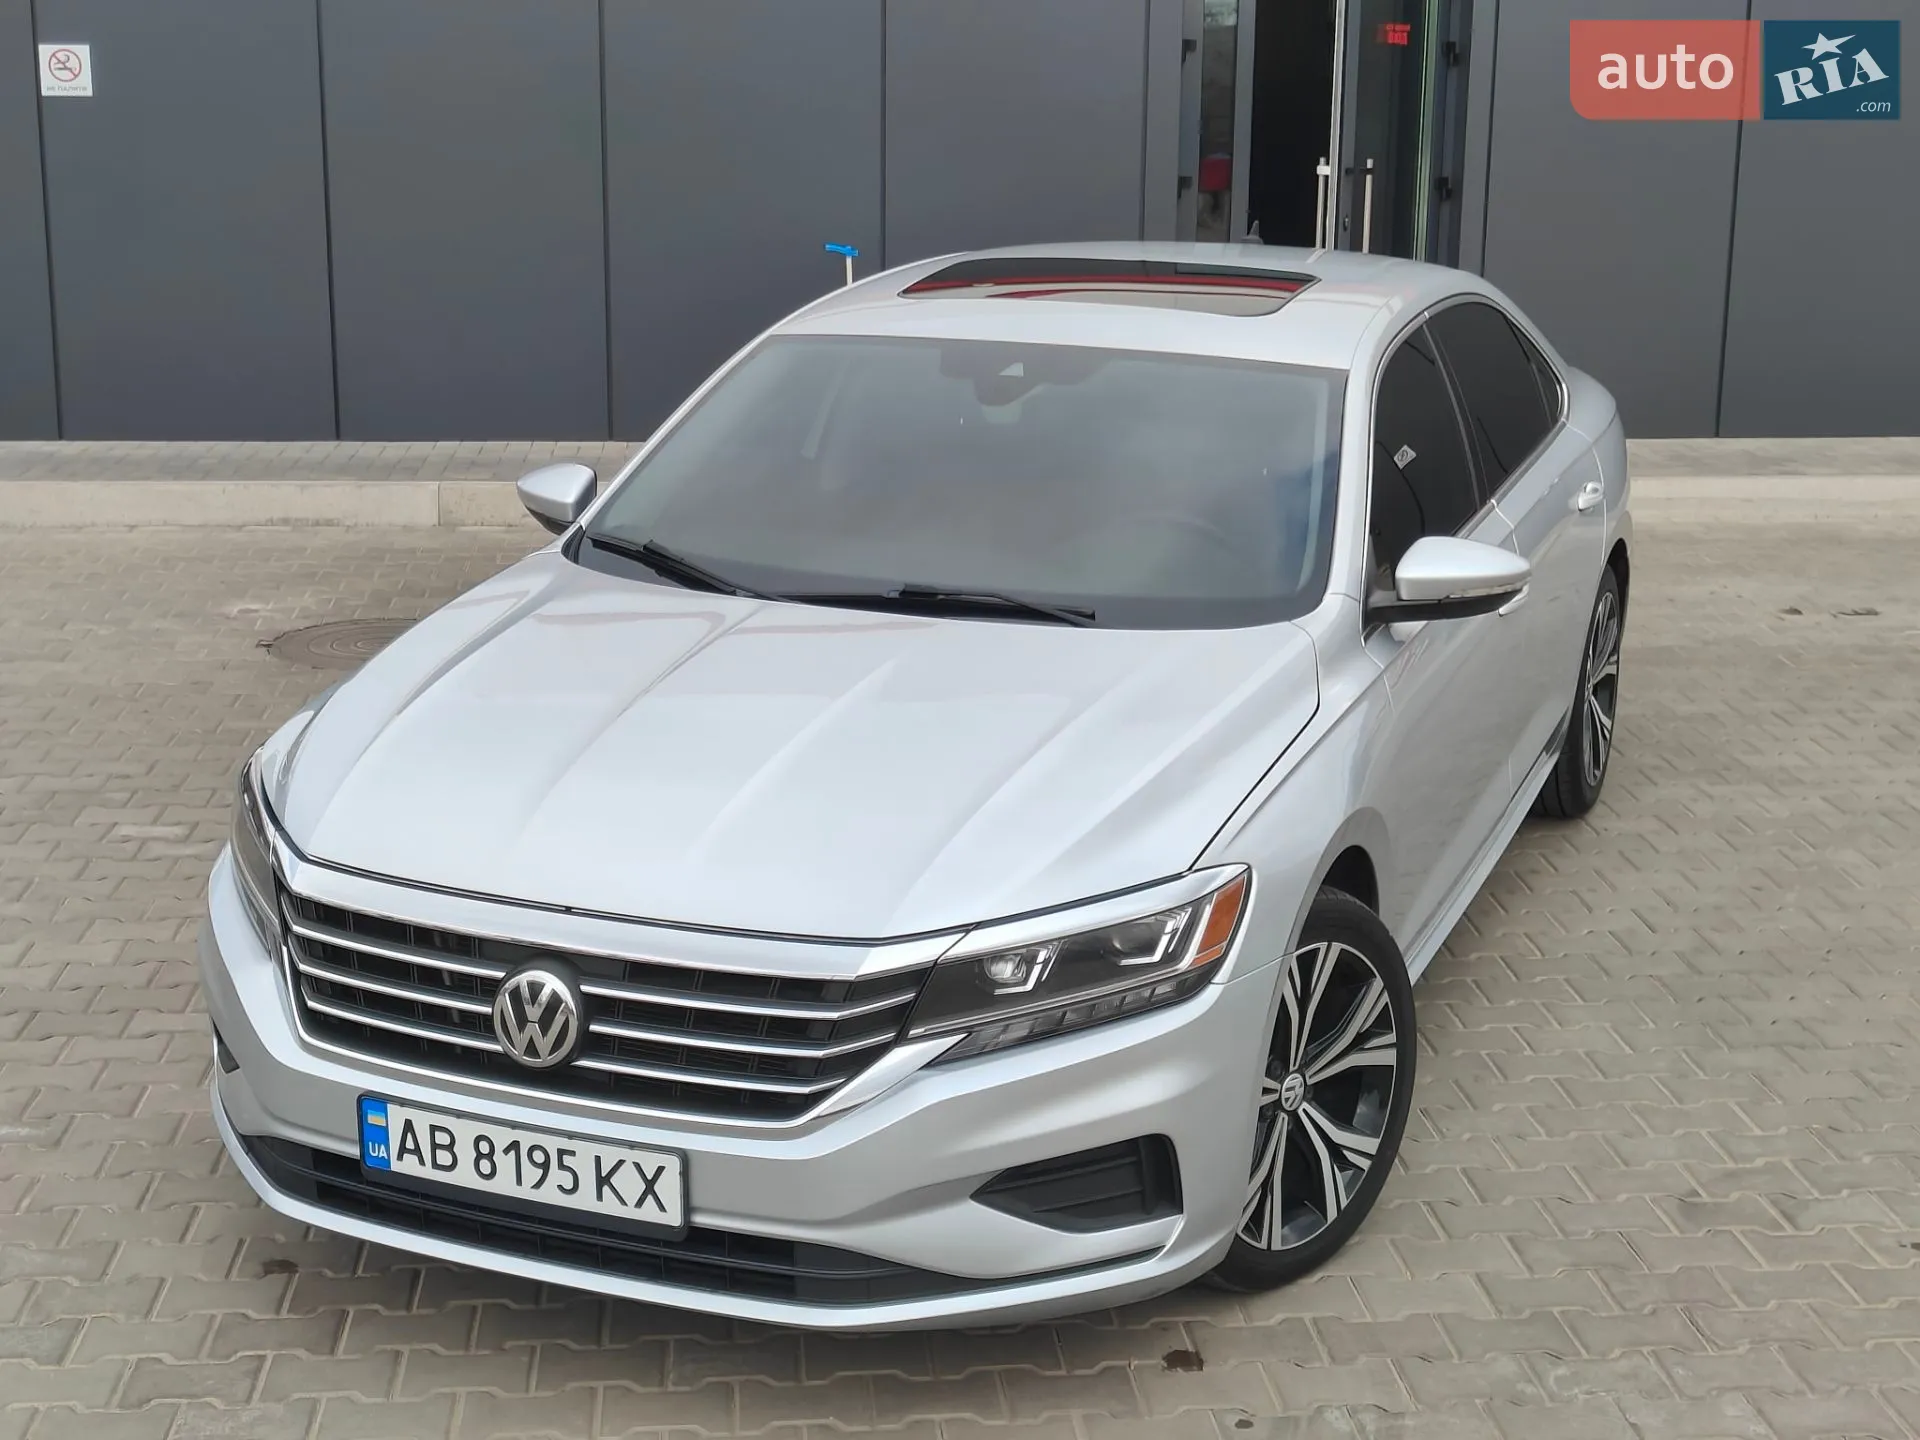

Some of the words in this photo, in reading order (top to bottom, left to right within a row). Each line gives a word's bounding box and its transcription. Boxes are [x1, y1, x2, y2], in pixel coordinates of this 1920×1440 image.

[368, 1140, 388, 1160] UA
[396, 1118, 458, 1173] AB
[473, 1134, 579, 1196] 8195
[594, 1154, 667, 1213] KX
